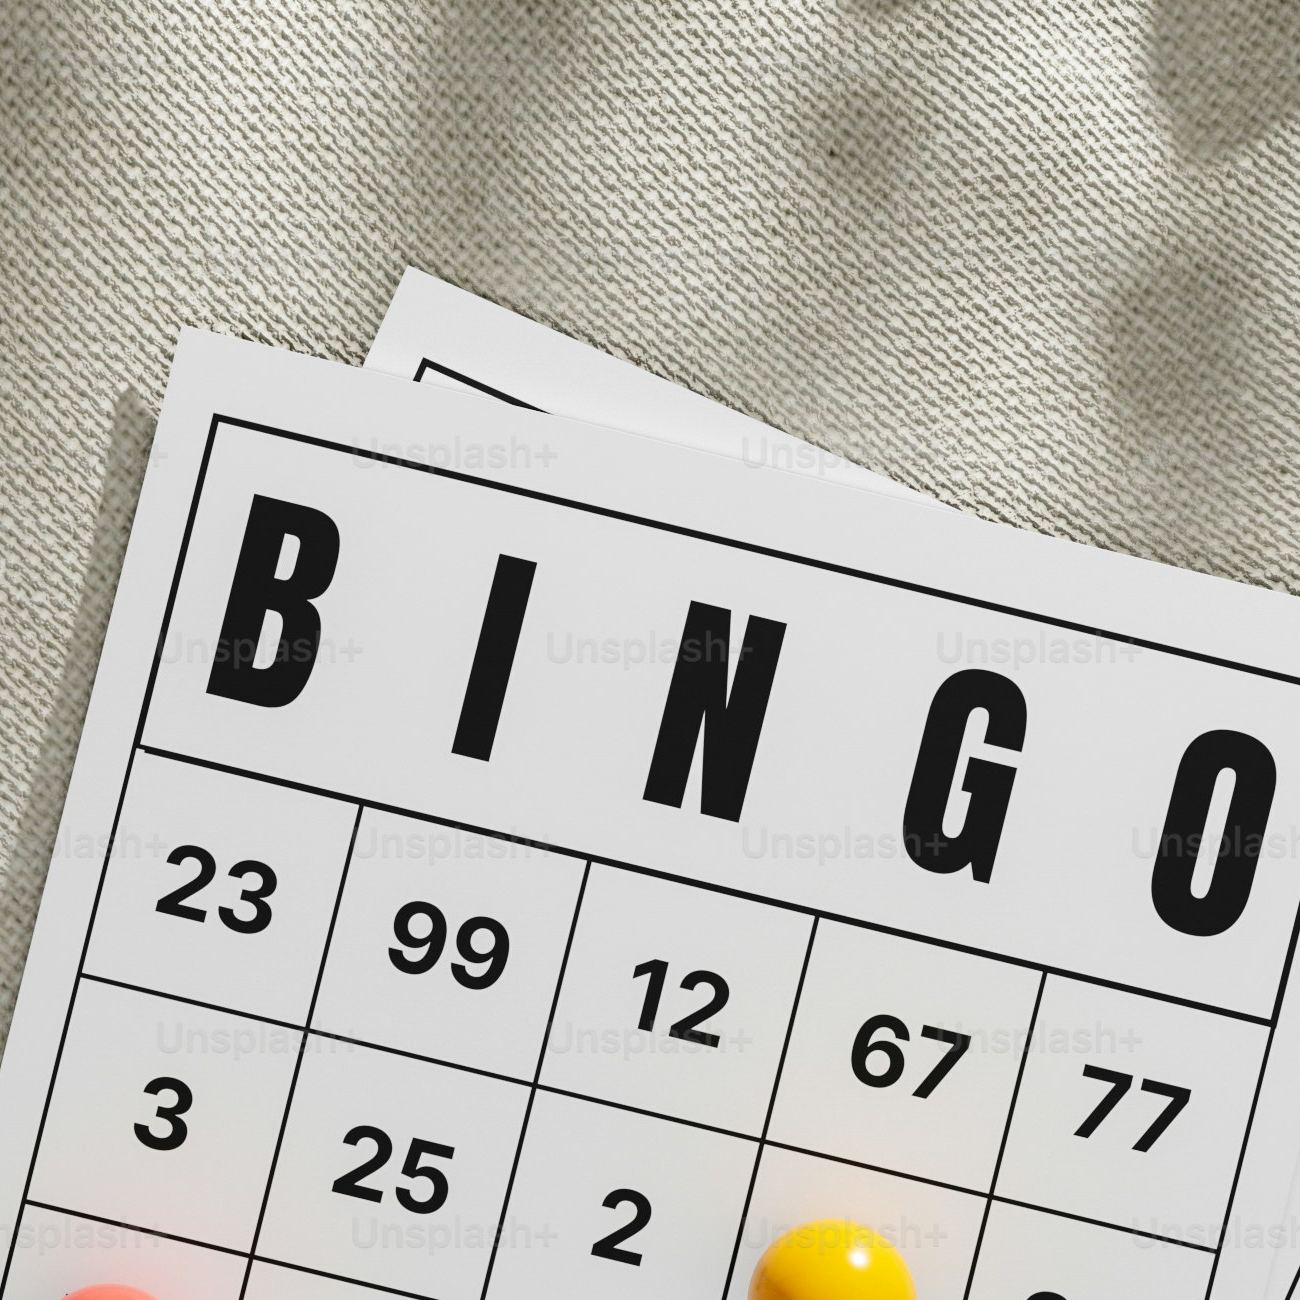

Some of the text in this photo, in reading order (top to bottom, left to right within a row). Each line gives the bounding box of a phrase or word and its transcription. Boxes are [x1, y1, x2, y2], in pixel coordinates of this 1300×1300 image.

[155, 844, 1192, 1153] 23 99 12 67 77
[133, 1076, 193, 1151] 3
[331, 1125, 455, 1215] 25
[590, 1188, 652, 1267] 2
